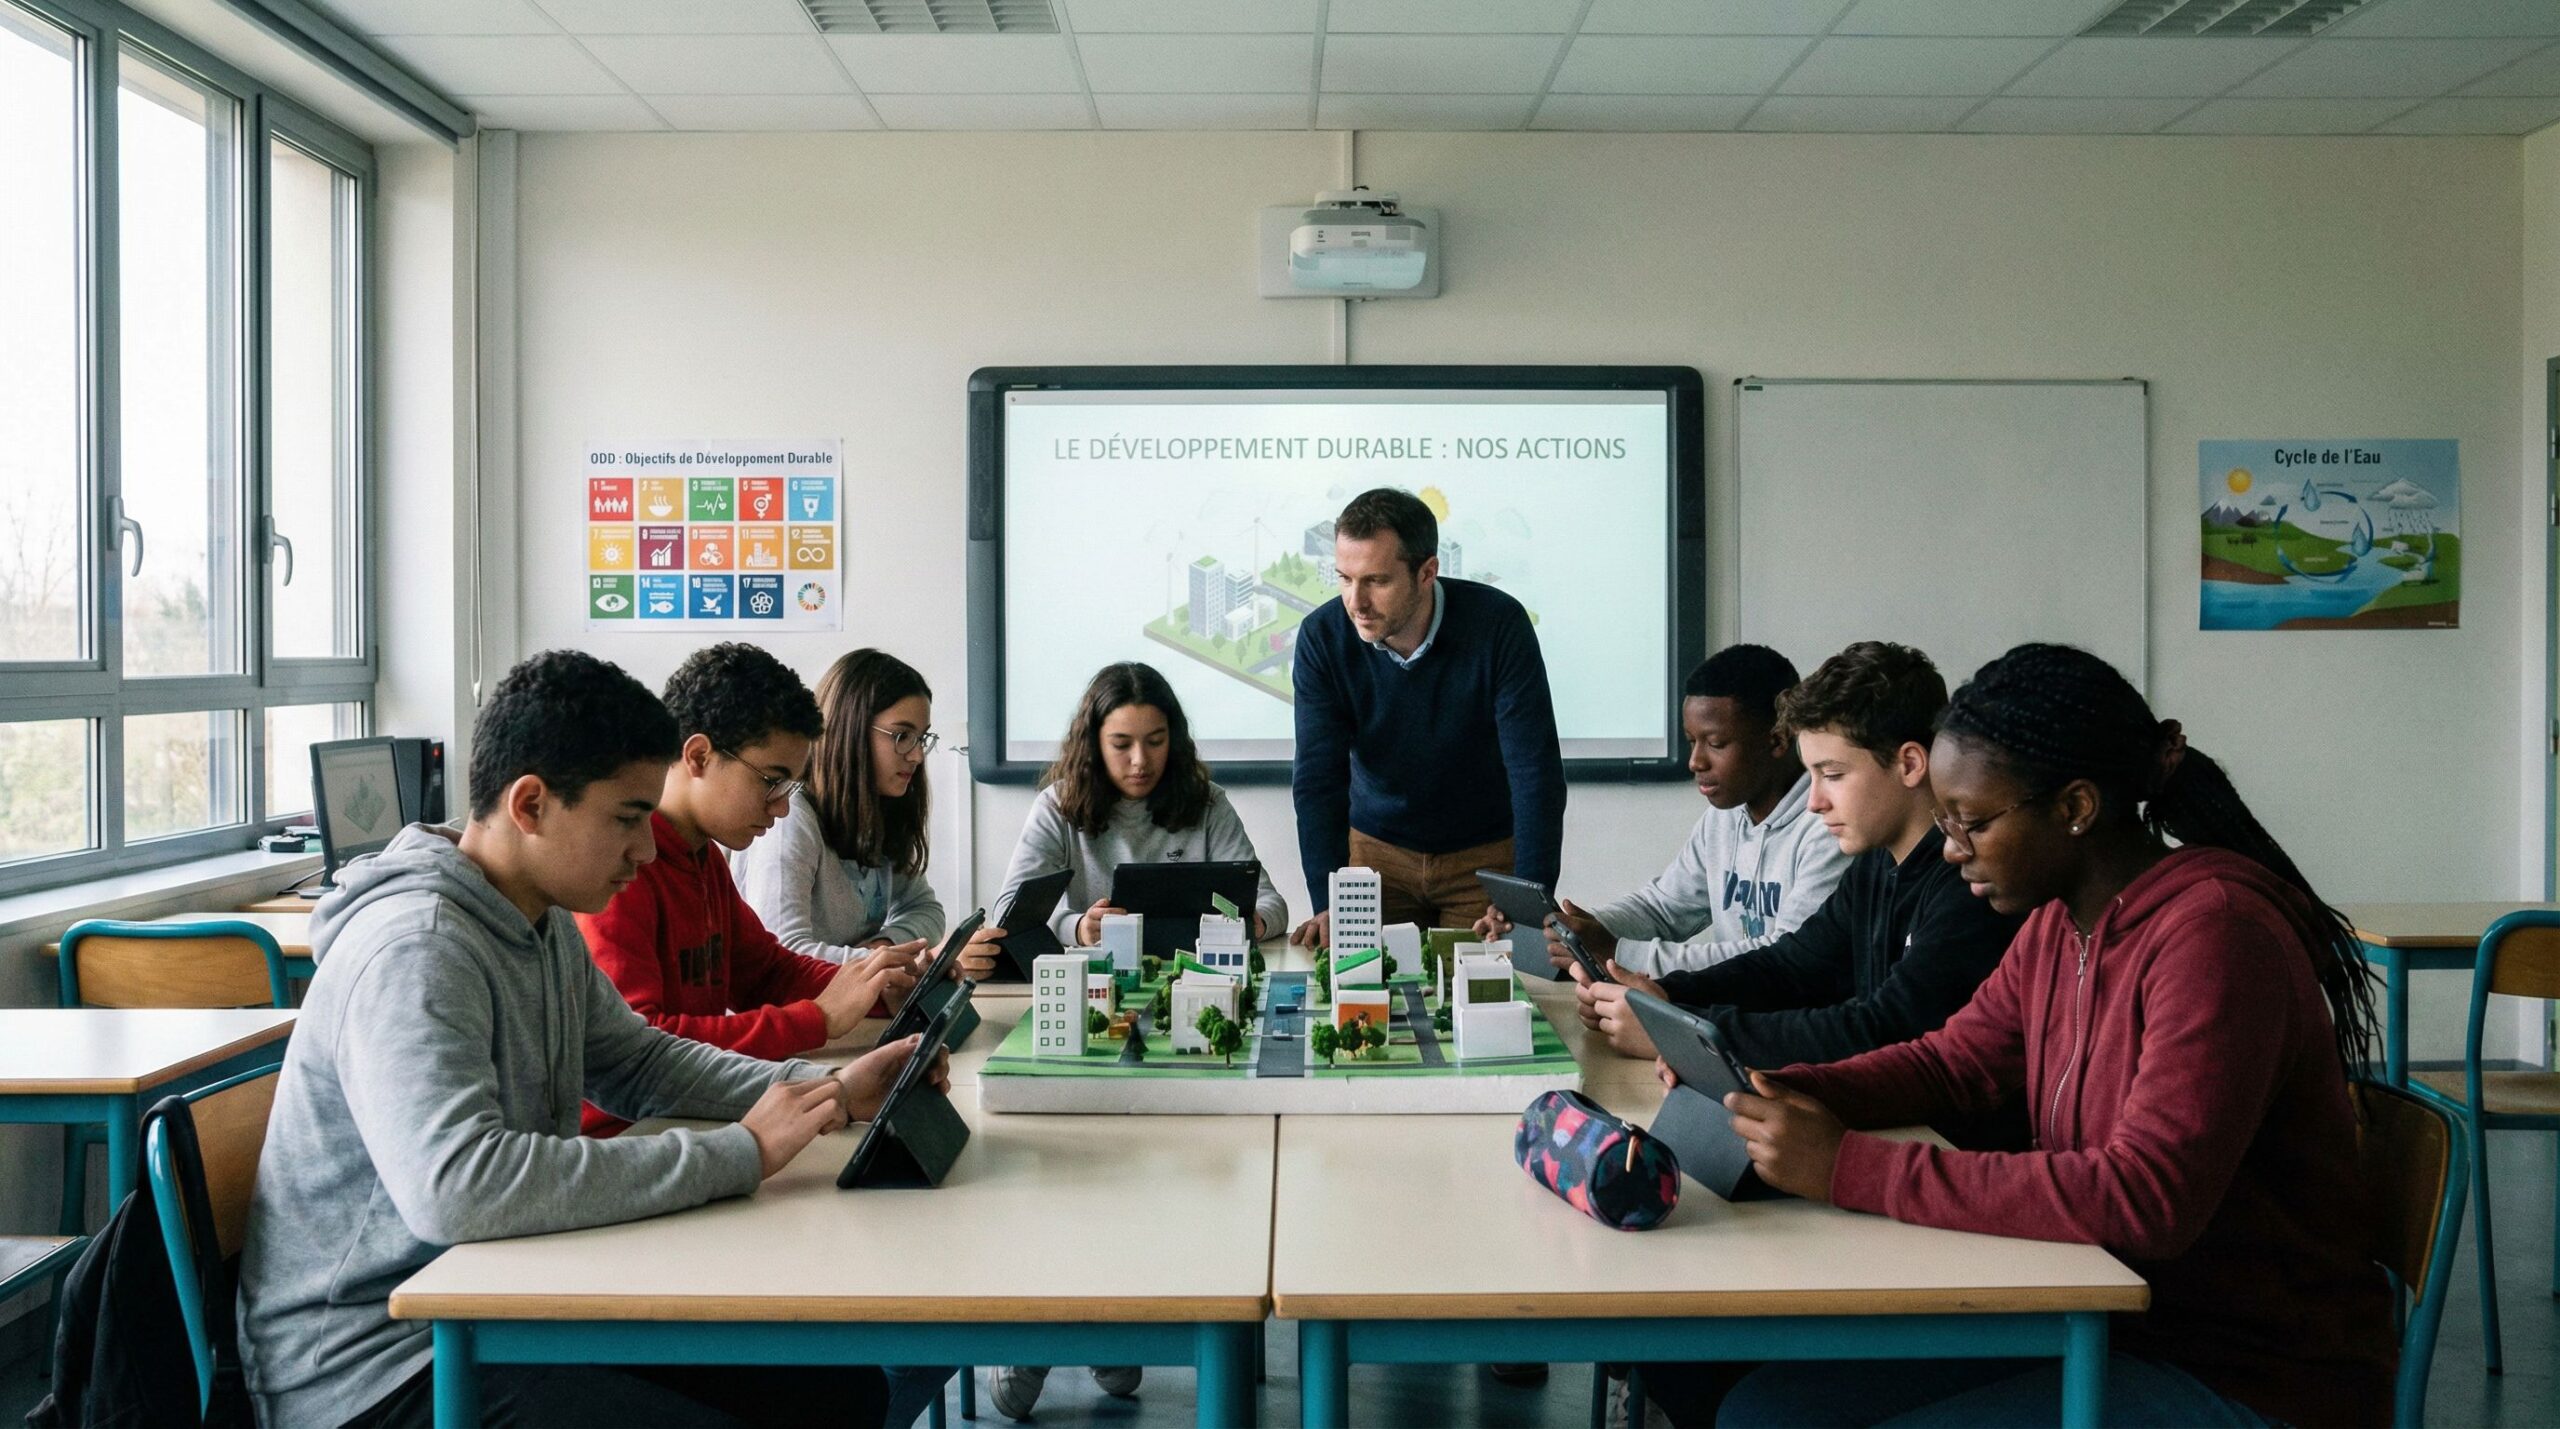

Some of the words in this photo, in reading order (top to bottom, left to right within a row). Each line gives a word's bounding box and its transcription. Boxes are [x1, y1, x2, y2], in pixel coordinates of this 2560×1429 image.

[1054, 438, 1080, 460] LE
[1090, 432, 1309, 460] DÉVELOPPEMENT
[1317, 437, 1432, 459] DURABLE
[1456, 437, 1508, 459] NOS
[1516, 437, 1626, 459] ACTIONS
[590, 452, 616, 464] ODD
[625, 452, 676, 467] Objectifs
[679, 452, 693, 464] de
[788, 452, 833, 464] Durable
[2274, 448, 2317, 468] Cycle
[2321, 449, 2340, 464] de
[2344, 448, 2381, 464] l'Eau
